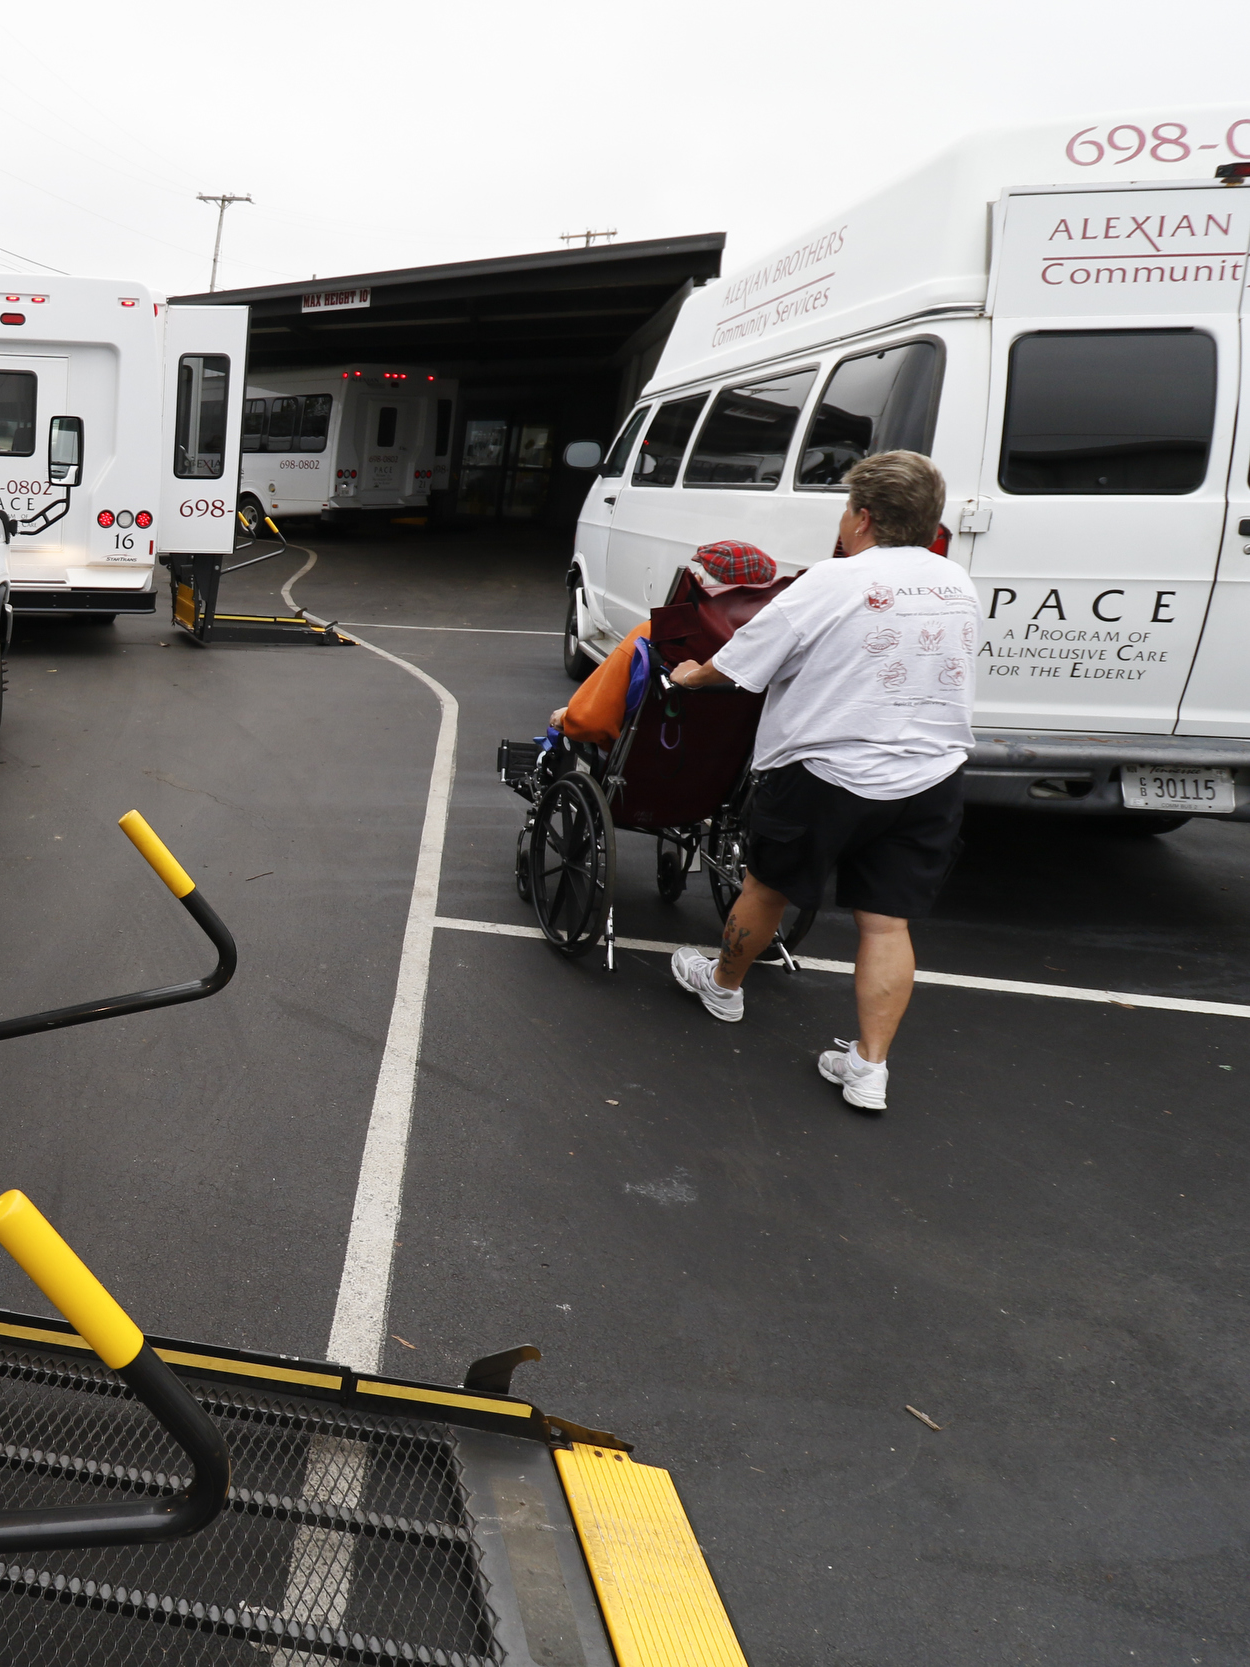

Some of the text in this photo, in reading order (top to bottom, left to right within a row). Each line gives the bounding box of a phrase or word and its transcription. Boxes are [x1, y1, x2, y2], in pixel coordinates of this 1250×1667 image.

[1048, 212, 1233, 252] ALEXIAN
[721, 224, 848, 310] ALEXIAN BROTHERS
[1041, 259, 1250, 288] Communit
[303, 294, 322, 308] MAX
[324, 290, 357, 306] HEIGHT
[711, 287, 831, 348] Community Services
[279, 459, 320, 470] 698-0802
[374, 466, 393, 474] PACE
[179, 498, 235, 518] 698-
[114, 532, 135, 550] 16
[895, 586, 963, 599] ALEXIAN
[987, 587, 1177, 623] PACE
[1003, 623, 1151, 643] A PROGRAM OF
[977, 641, 1169, 663] ALL-INCLUSIVE CARE
[988, 662, 1146, 680] FOR THE ELDERLY
[1152, 777, 1216, 801] 30115
